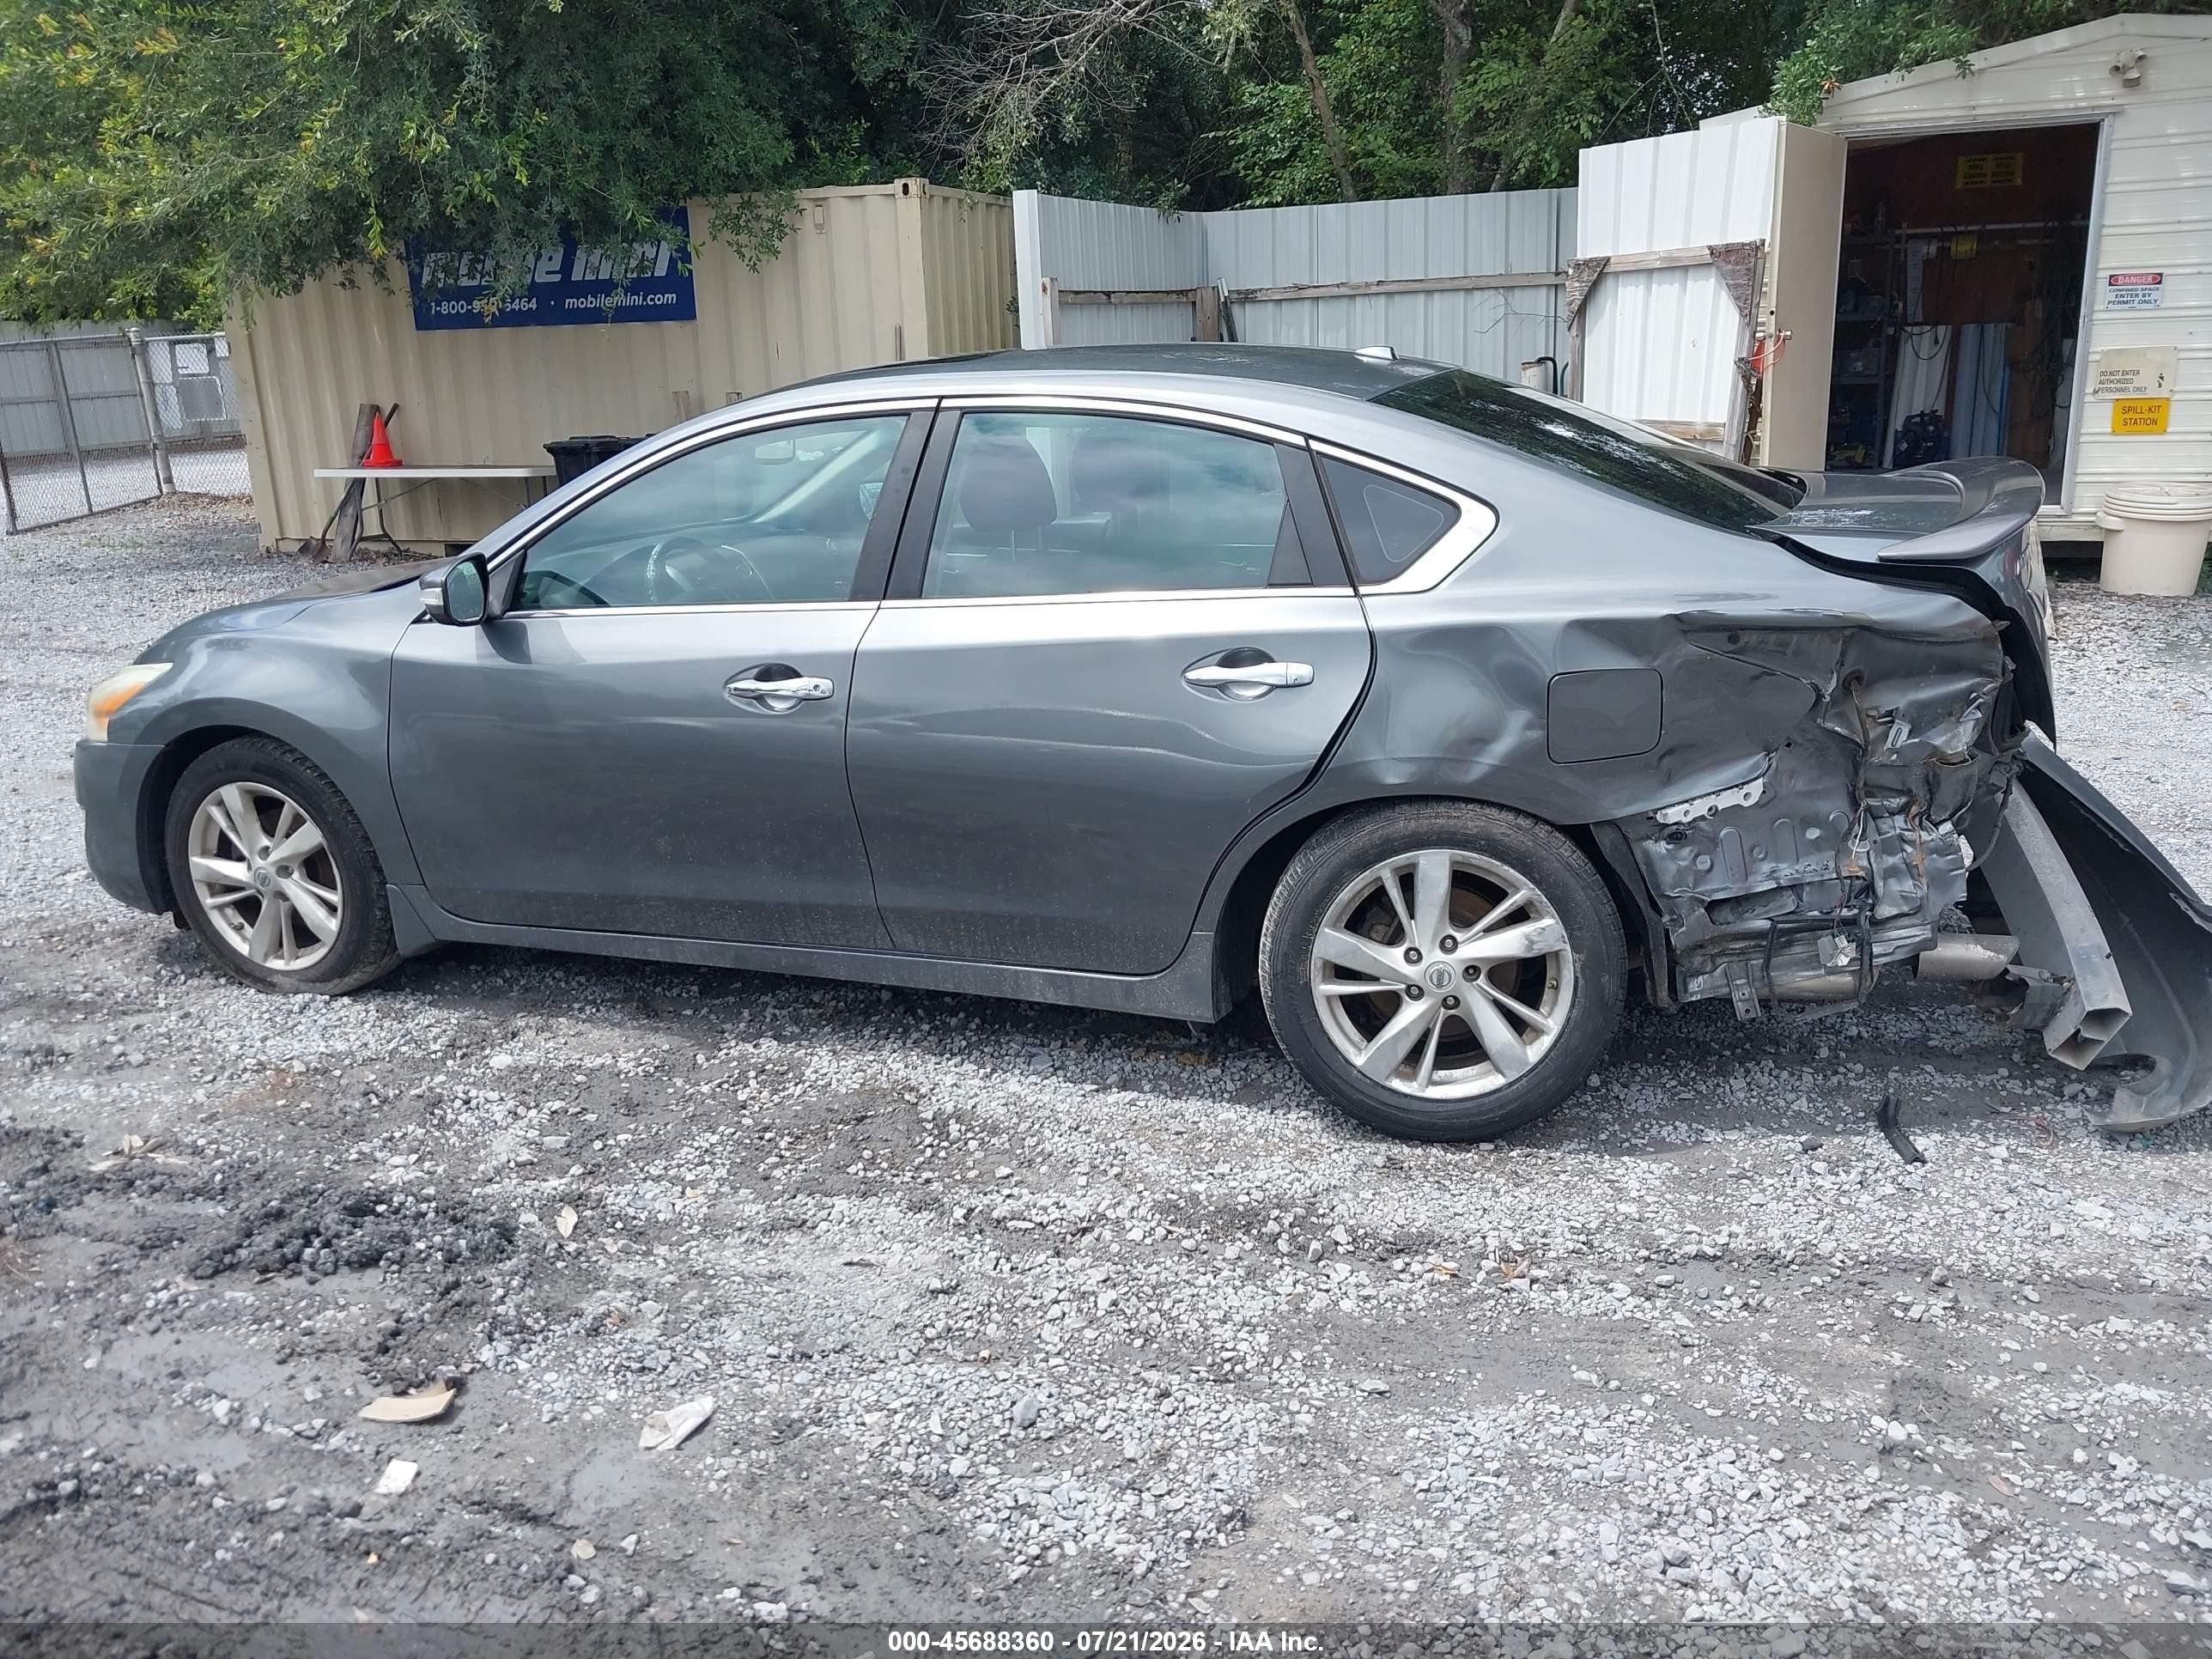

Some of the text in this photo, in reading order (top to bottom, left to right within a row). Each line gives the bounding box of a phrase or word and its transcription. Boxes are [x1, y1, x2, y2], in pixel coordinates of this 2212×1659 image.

[2118, 275, 2153, 284] DANGER
[564, 292, 677, 309] mobilemini.com
[2122, 405, 2162, 415] SPILL-KIT
[2122, 417, 2158, 427] STATION
